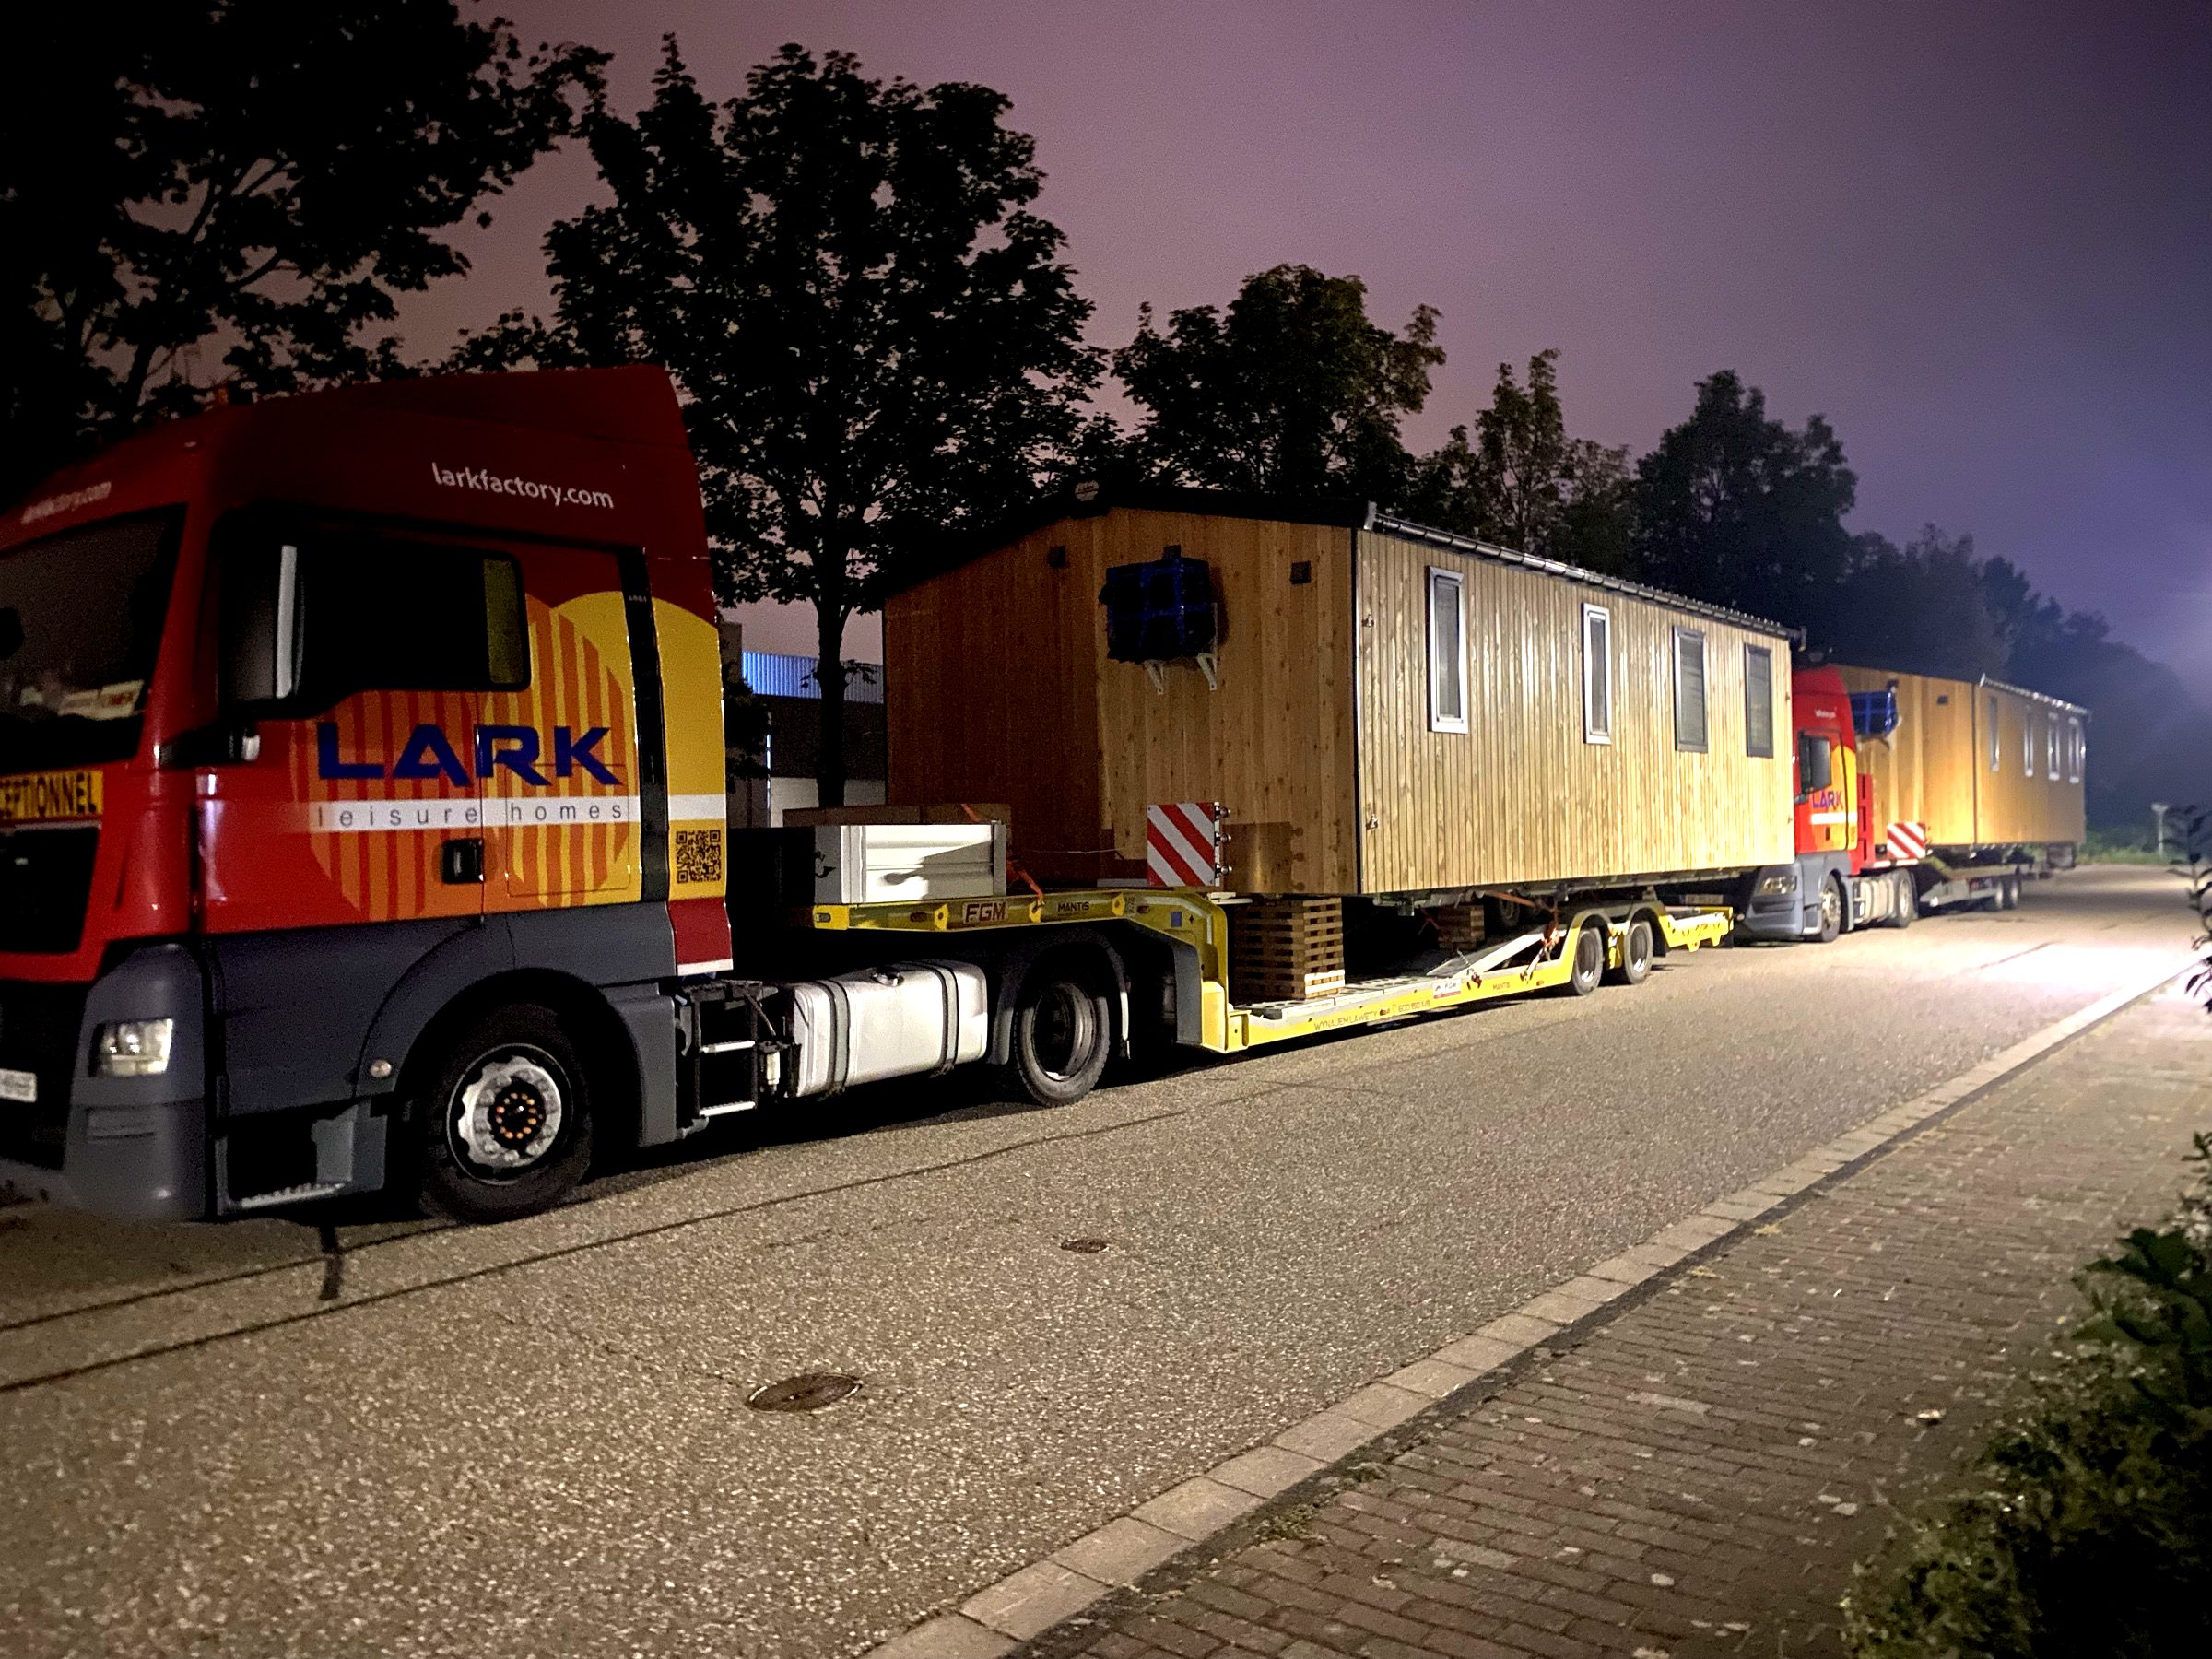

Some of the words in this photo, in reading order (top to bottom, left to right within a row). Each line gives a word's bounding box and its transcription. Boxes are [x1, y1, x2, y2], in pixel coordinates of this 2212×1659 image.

[431, 461, 614, 509] larkfactory.com
[316, 722, 623, 788] LARK
[1812, 790, 1844, 811] LARK
[318, 805, 478, 828] leisure
[510, 802, 623, 822] homes
[1057, 901, 1090, 912] MANTIS
